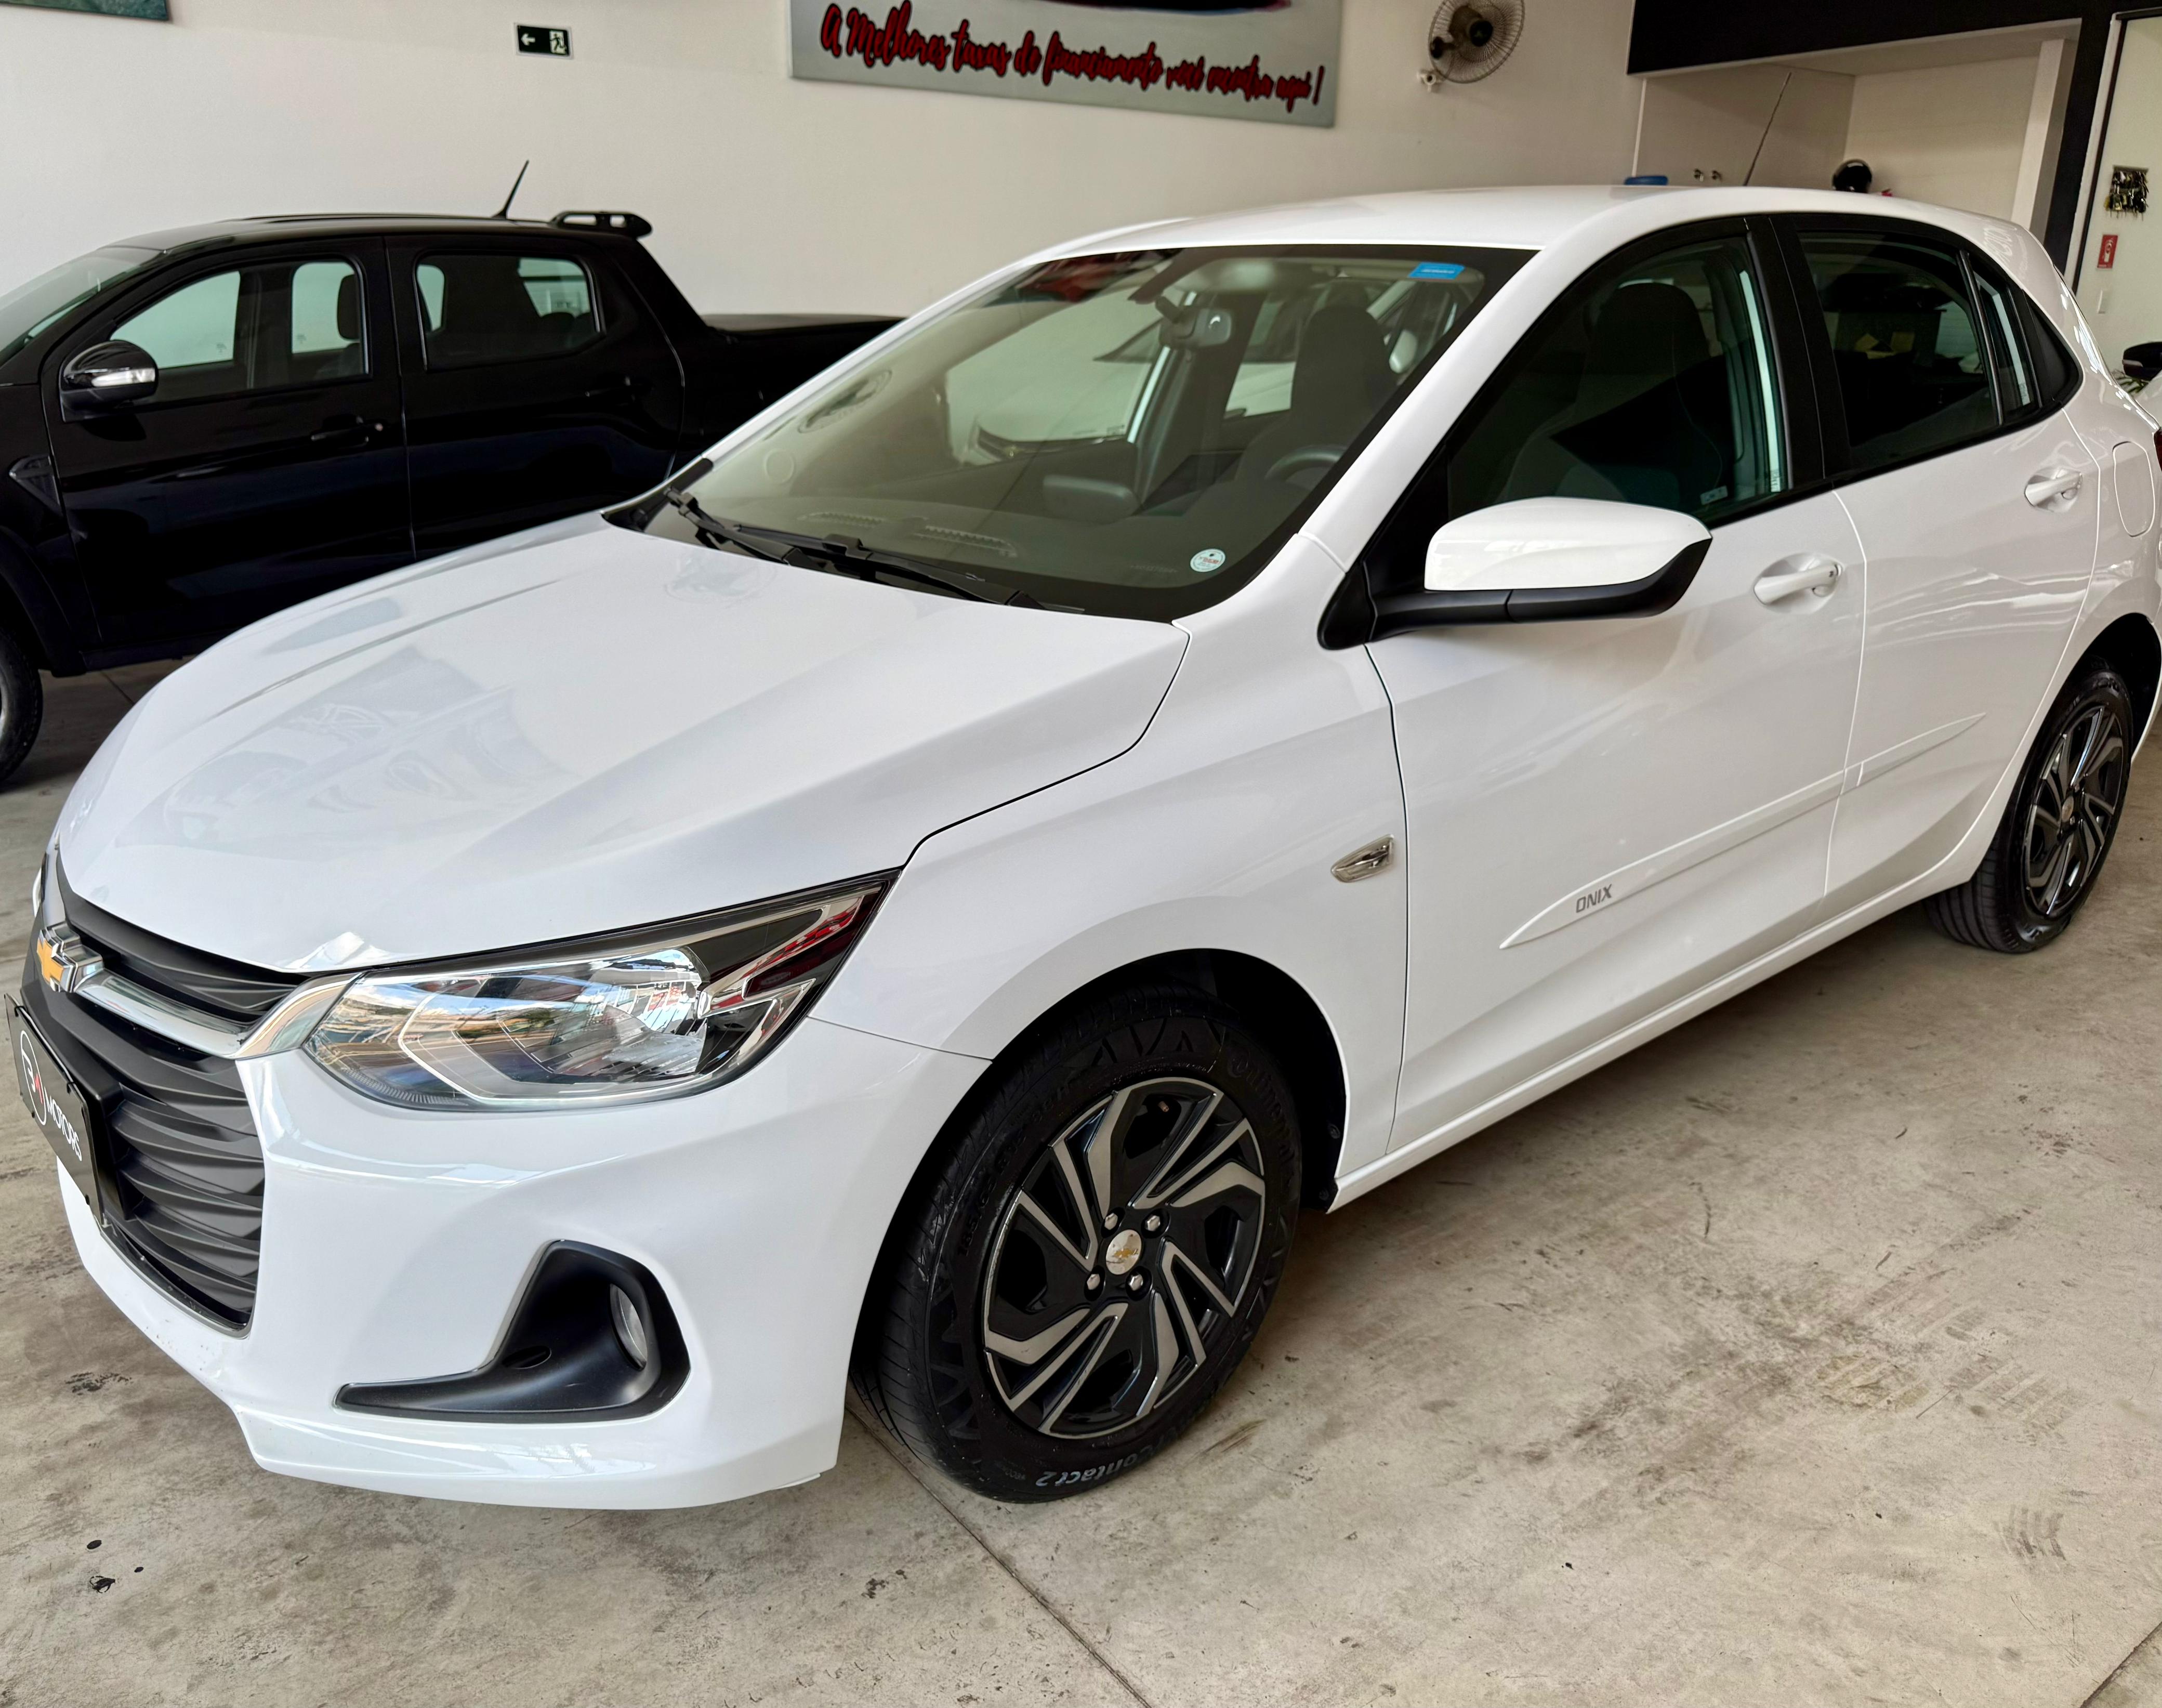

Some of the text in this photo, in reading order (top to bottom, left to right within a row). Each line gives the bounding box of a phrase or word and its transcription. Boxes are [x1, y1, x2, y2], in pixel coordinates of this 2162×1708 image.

[821, 4, 842, 58] A
[847, 0, 951, 71] Melhores
[1576, 884, 1612, 913] ONIX
[44, 1086, 83, 1161] MOTORS
